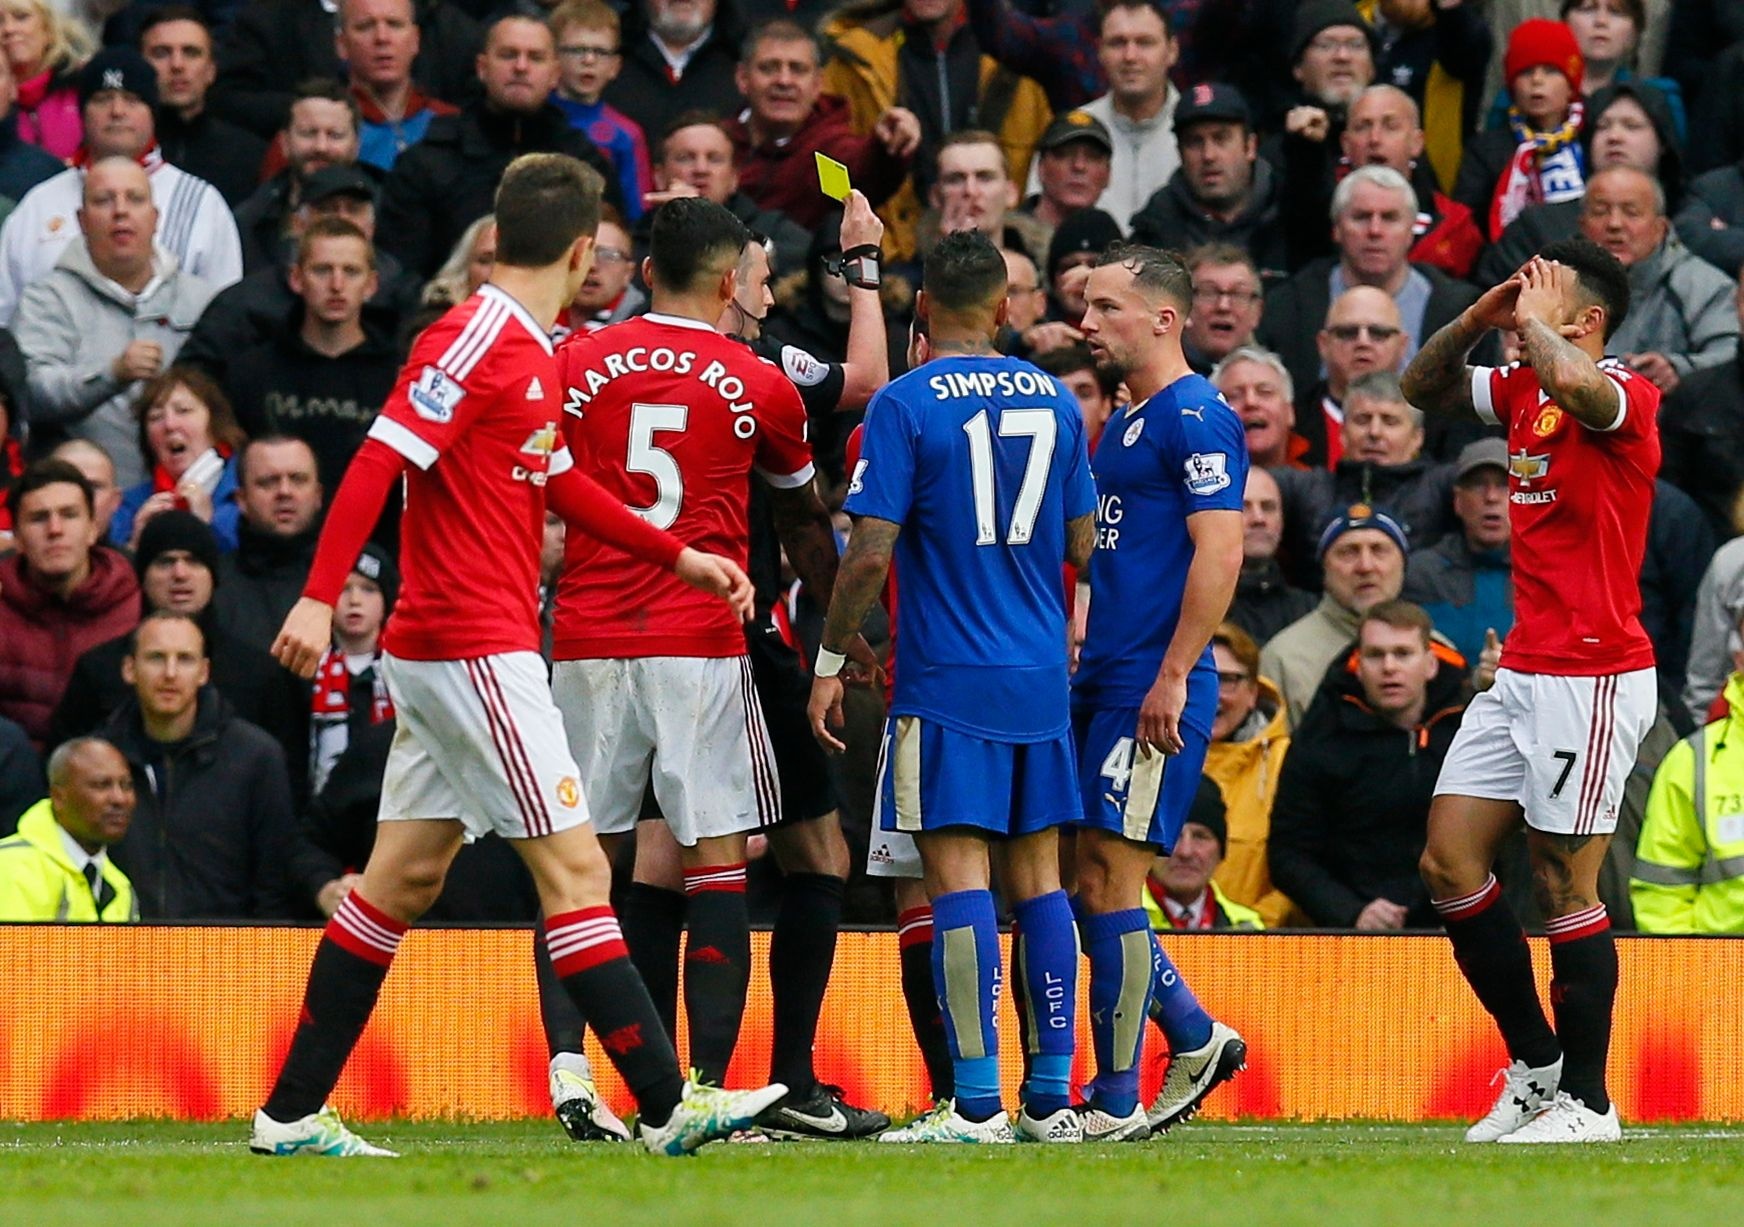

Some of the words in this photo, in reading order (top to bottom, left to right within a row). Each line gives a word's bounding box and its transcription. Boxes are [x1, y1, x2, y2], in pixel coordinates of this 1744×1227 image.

[563, 347, 697, 420] MARCOS
[699, 360, 756, 439] ROJO
[929, 371, 1058, 400] SIMPSON
[625, 402, 689, 531] 5
[963, 408, 1058, 546] 17
[1100, 736, 1134, 792] 4
[1549, 749, 1579, 799] 7
[1045, 972, 1067, 1028] LCFC
